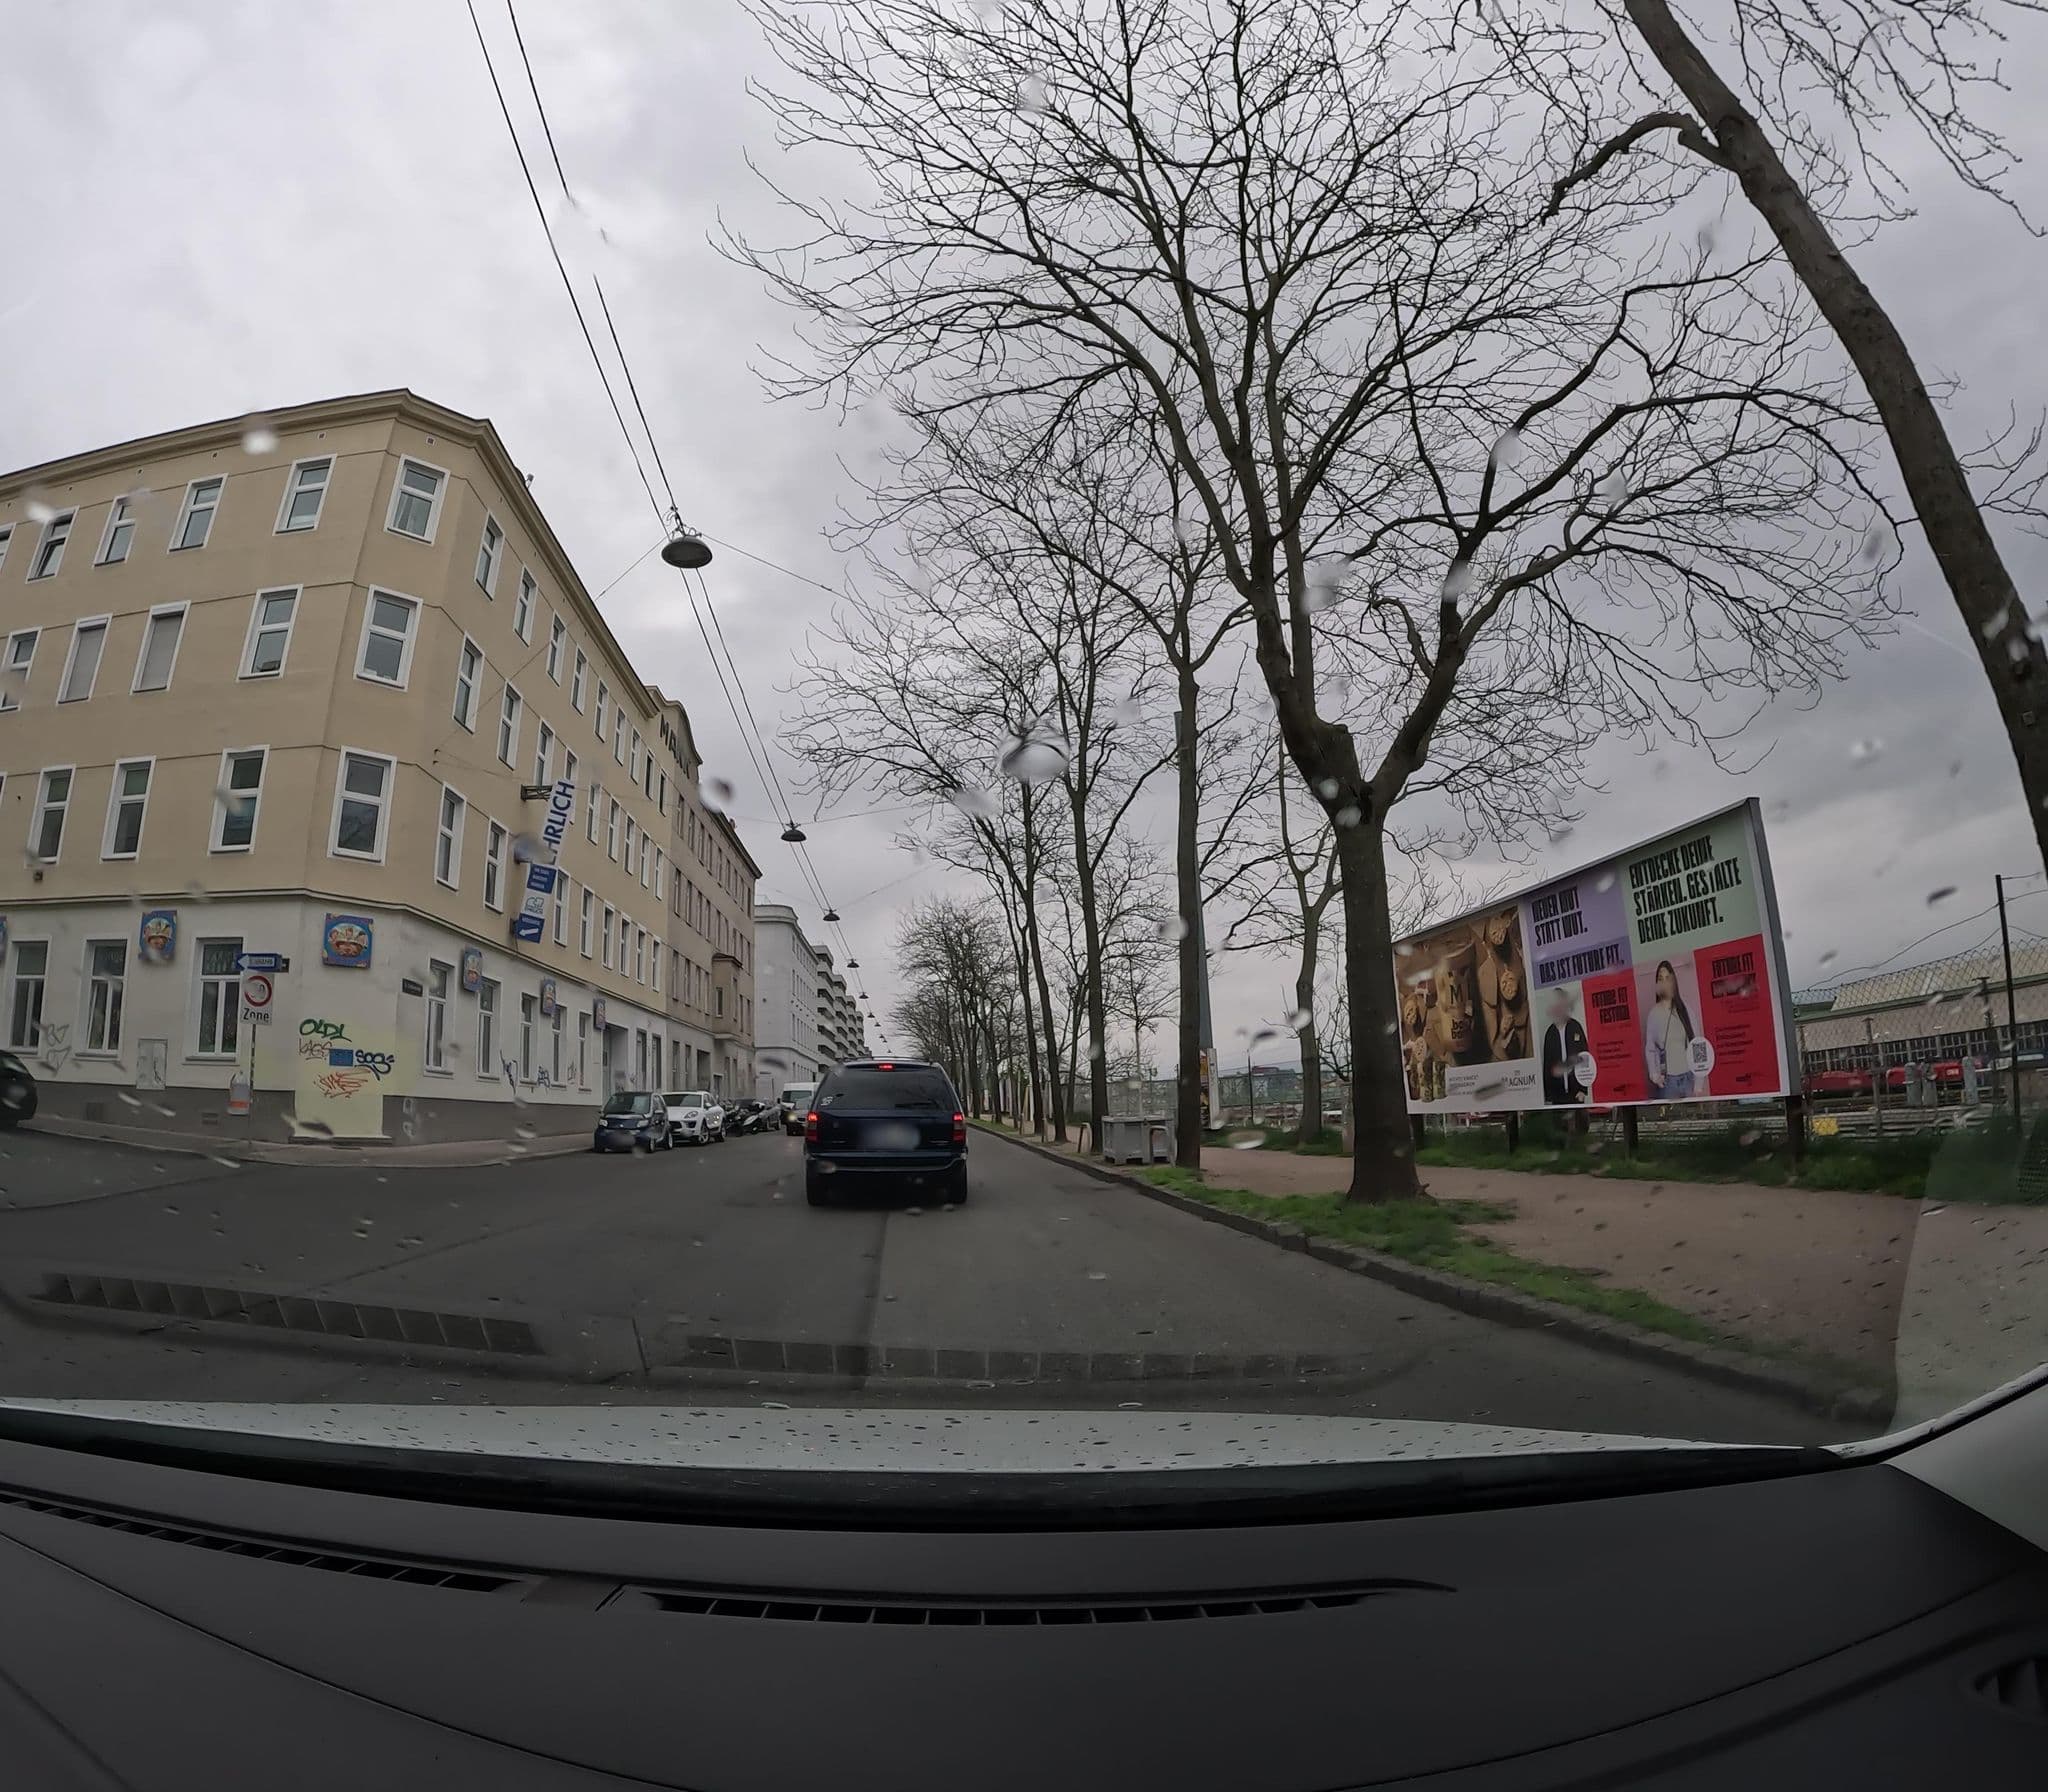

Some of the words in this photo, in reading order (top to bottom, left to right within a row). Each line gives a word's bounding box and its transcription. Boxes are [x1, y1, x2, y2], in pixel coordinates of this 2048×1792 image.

[543, 779, 575, 867] HRLICH
[1629, 848, 1681, 889] ENTDECKE
[1680, 835, 1714, 871] DEINE
[1633, 877, 1687, 916] STÄRKEN.
[1686, 857, 1742, 900] GESTALTE
[1535, 919, 1561, 947] STATT
[1637, 912, 1668, 944] DEINE
[1668, 896, 1724, 936] ZUKUNFT.
[1539, 961, 1557, 984] DAS
[1556, 957, 1571, 980] IST
[1571, 949, 1606, 976] FUTURE
[243, 1007, 270, 1023] Zone
